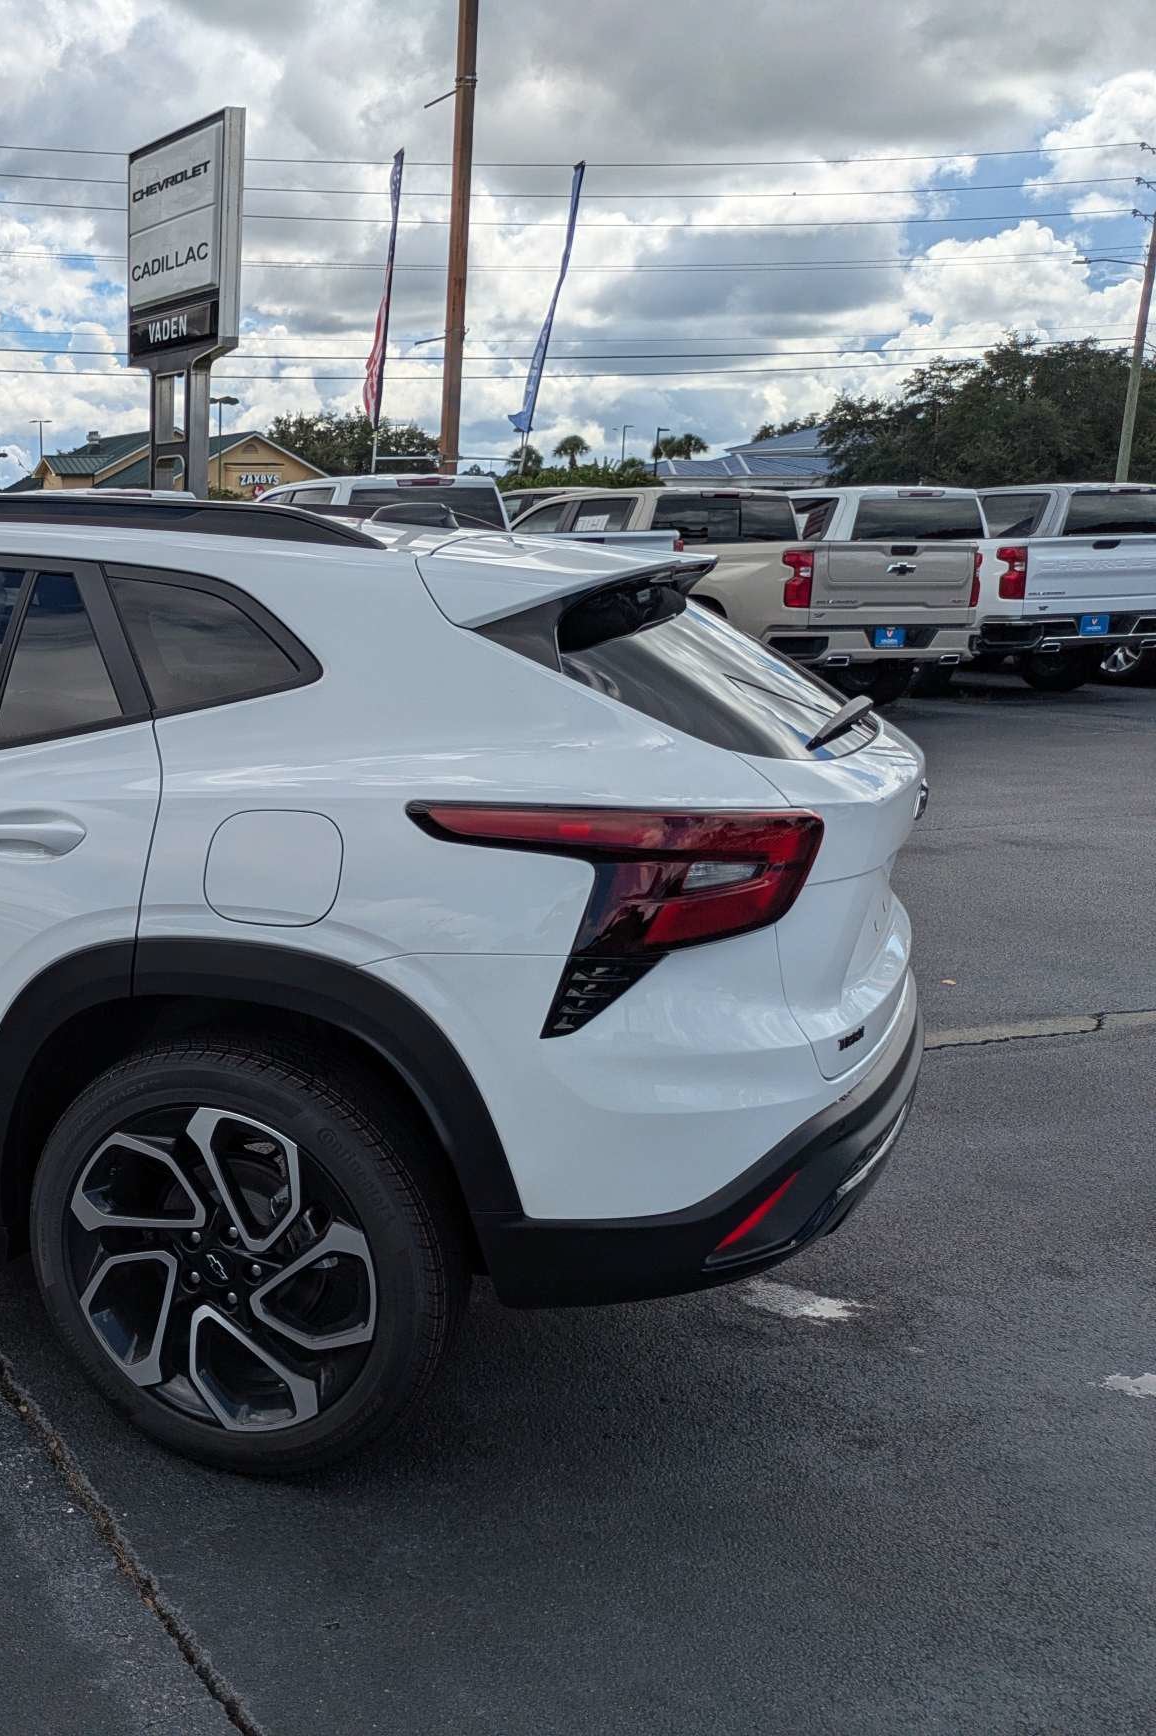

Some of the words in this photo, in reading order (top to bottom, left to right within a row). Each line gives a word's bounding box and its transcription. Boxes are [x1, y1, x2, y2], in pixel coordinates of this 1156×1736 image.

[132, 159, 211, 203] CHEVROLET
[132, 242, 209, 282] CADILLAC
[148, 313, 188, 344] VADEN
[240, 473, 281, 486] ZAXBYS
